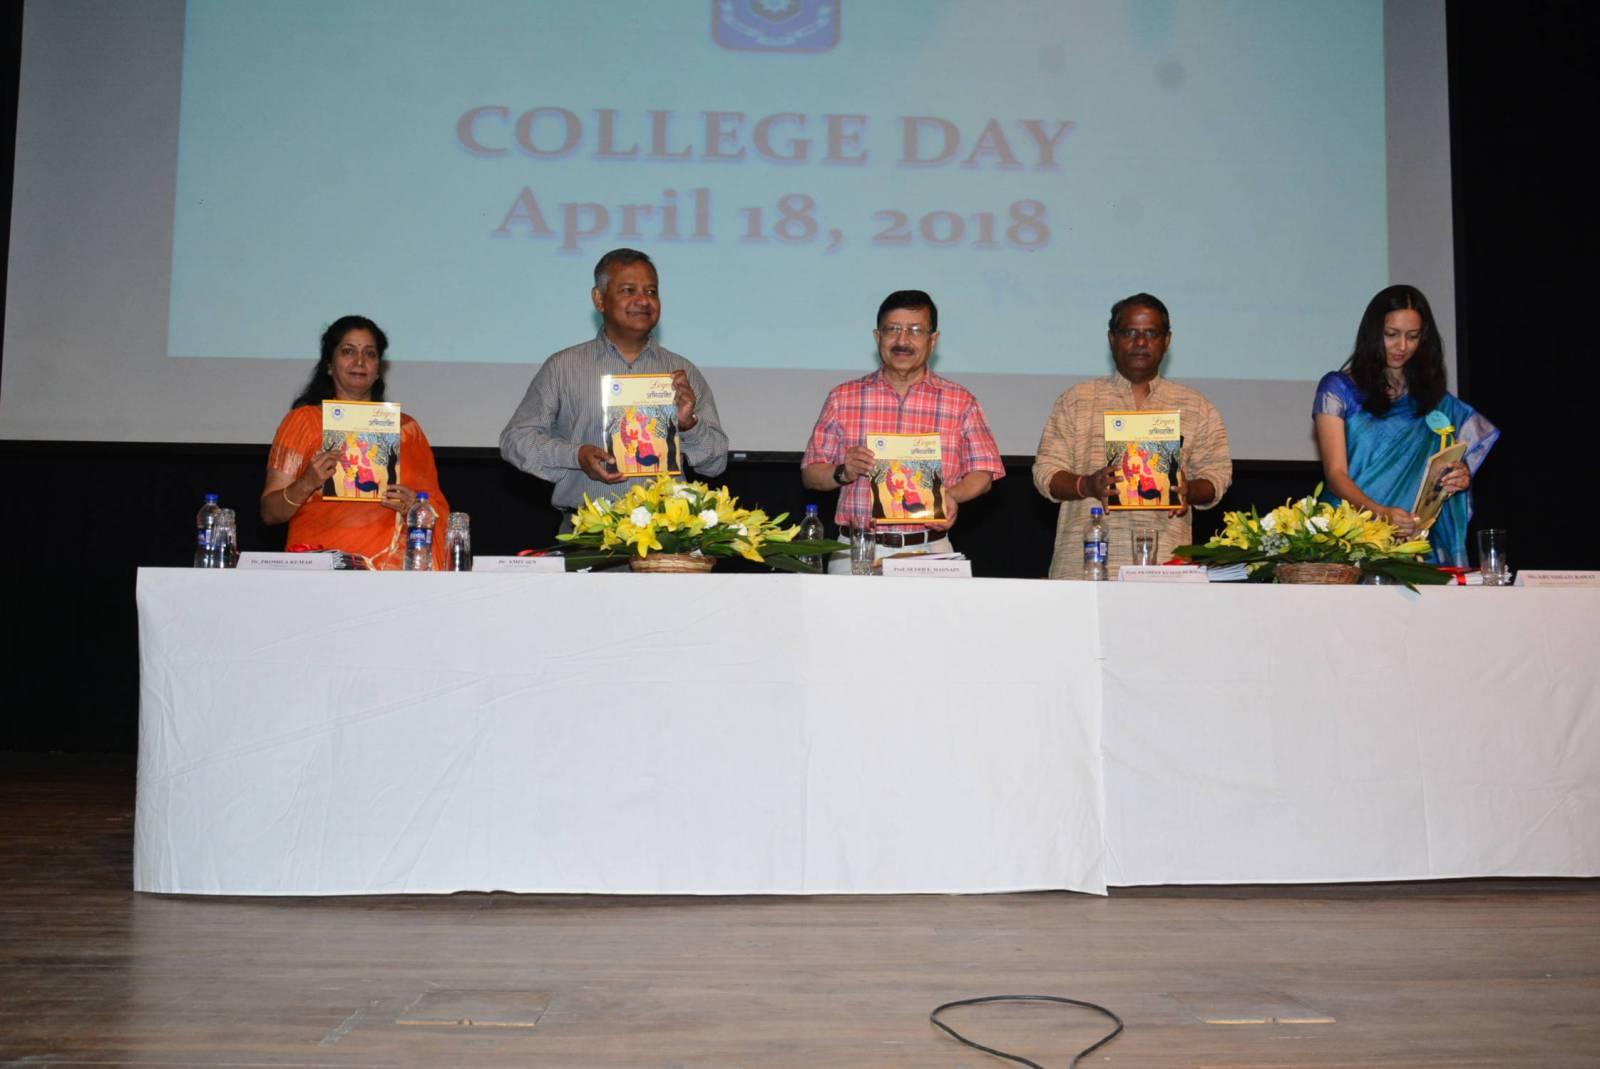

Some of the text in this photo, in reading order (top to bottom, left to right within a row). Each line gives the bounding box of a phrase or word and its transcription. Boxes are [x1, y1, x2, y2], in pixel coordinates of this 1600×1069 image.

[457, 105, 1077, 169] COLLEGE DAY
[492, 185, 1051, 252] April 18, 2018
